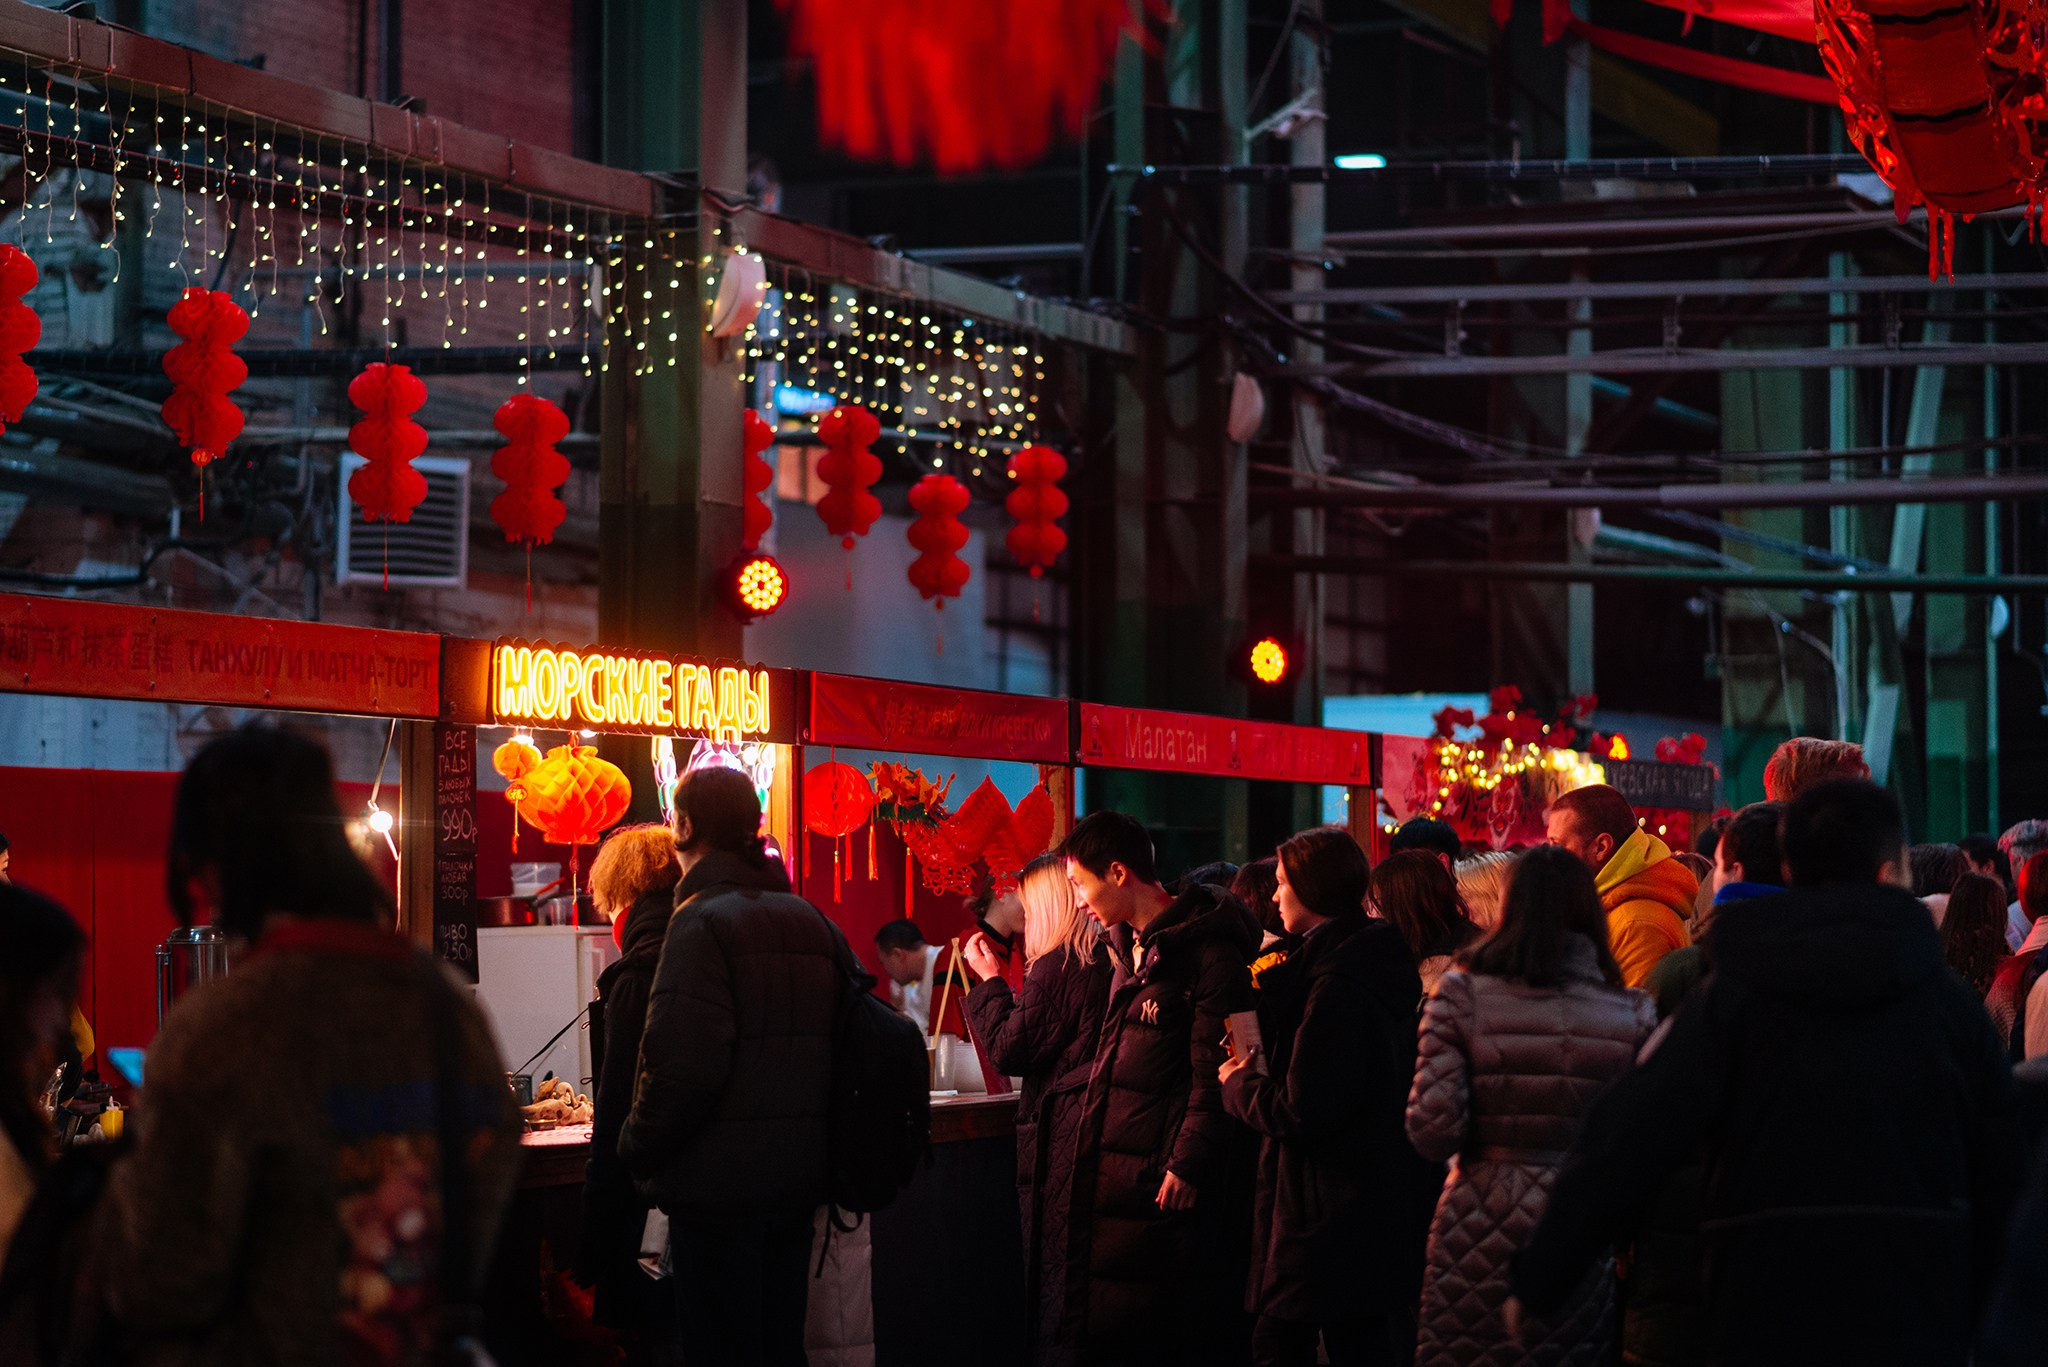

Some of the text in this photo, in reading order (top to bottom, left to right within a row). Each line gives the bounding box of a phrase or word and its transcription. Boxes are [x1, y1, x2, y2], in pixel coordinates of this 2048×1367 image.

[186, 639, 432, 689] ТАНХУЛУ И МАТЧА-ТОРТ
[493, 644, 770, 745] МОРСКИЕ ГАДЫ
[445, 730, 468, 751] ВСЕ
[992, 715, 1051, 742] КРЕВЕТКИ
[1124, 713, 1207, 764] Малатан
[438, 750, 471, 776] ГАДЫ
[438, 776, 471, 792] 5 ЛЮБЫХ
[440, 923, 467, 941] ПИВО
[1140, 998, 1160, 1026] NY
